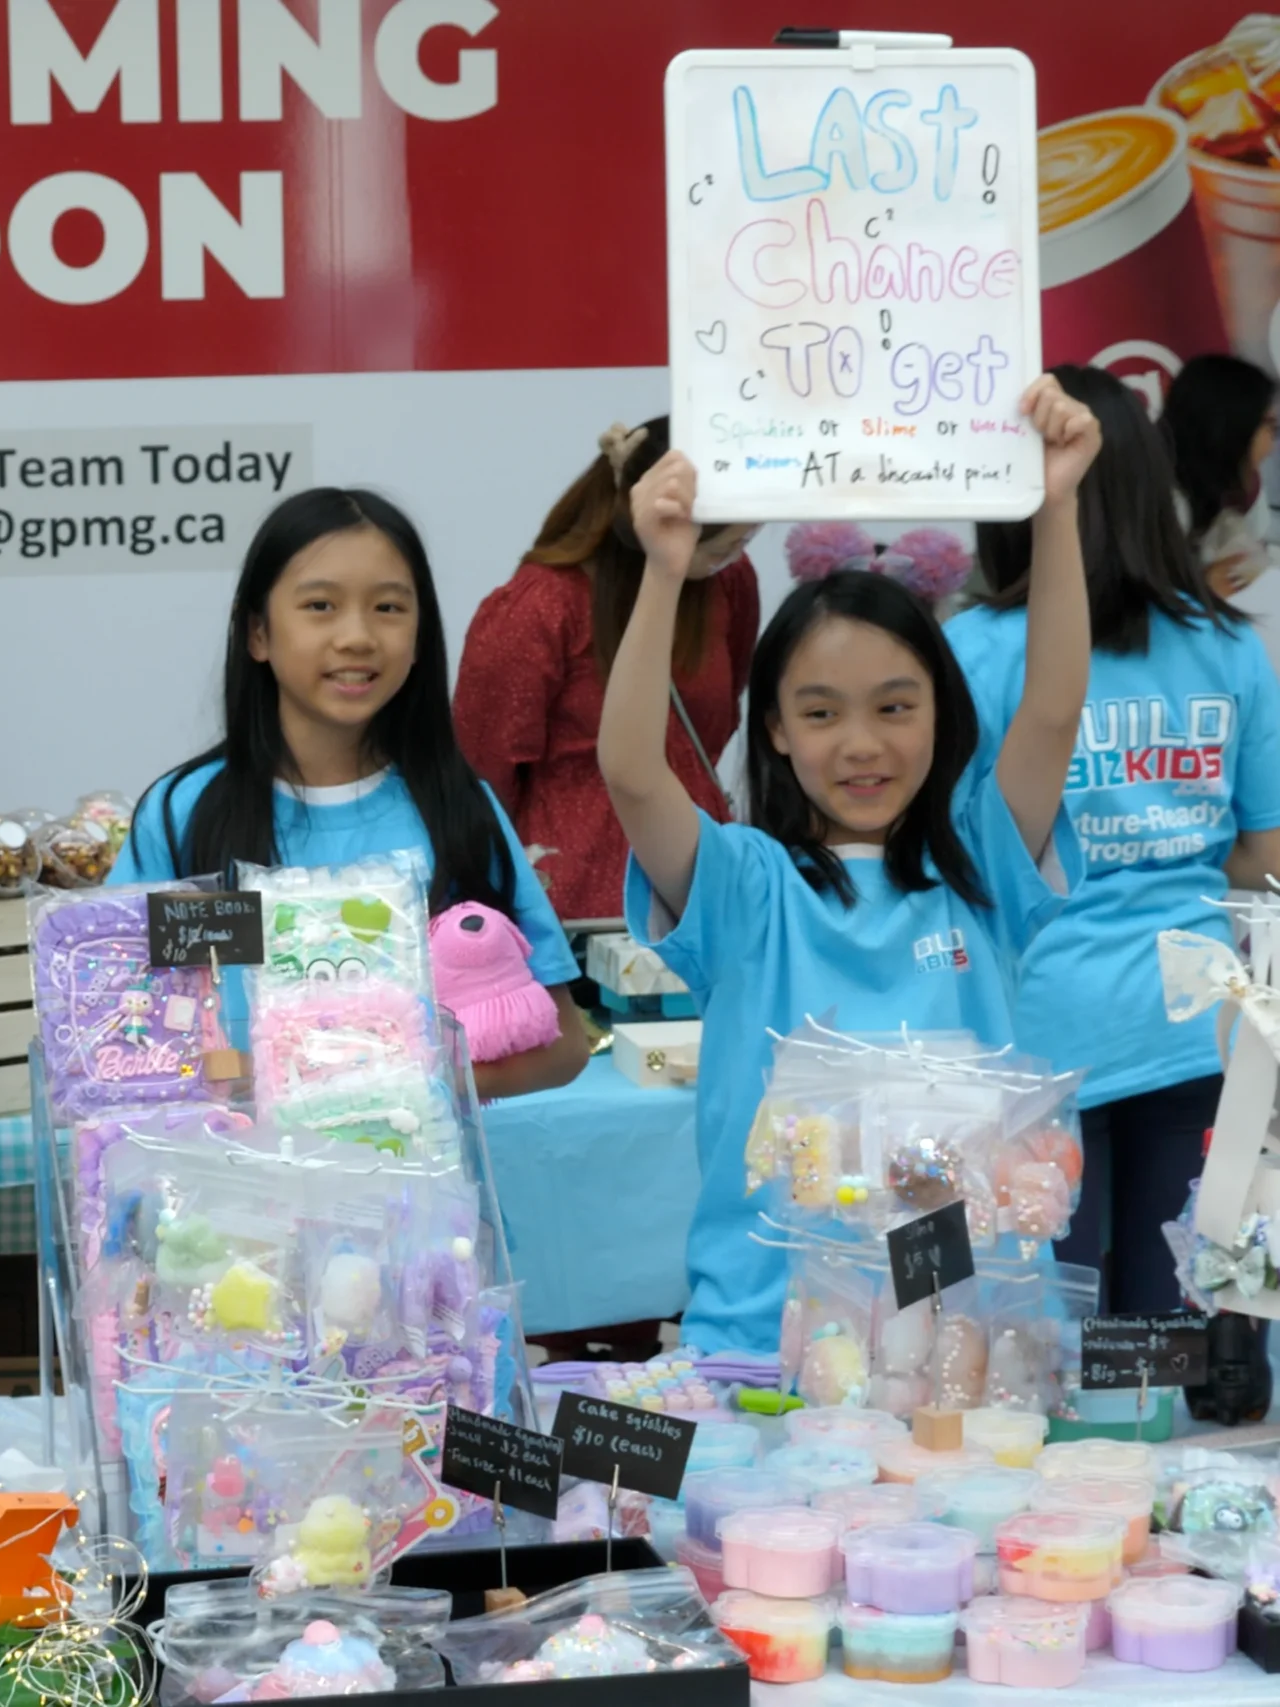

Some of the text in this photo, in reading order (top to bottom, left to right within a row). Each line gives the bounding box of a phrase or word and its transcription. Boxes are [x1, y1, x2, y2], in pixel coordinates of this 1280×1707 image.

[891, 335, 1009, 416] get
[141, 441, 292, 492] Today
[801, 449, 842, 488] AT
[850, 467, 866, 484] a
[1078, 695, 1235, 753] UILD
[95, 1044, 179, 1079] Barbie
[572, 1424, 605, 1447] $10
